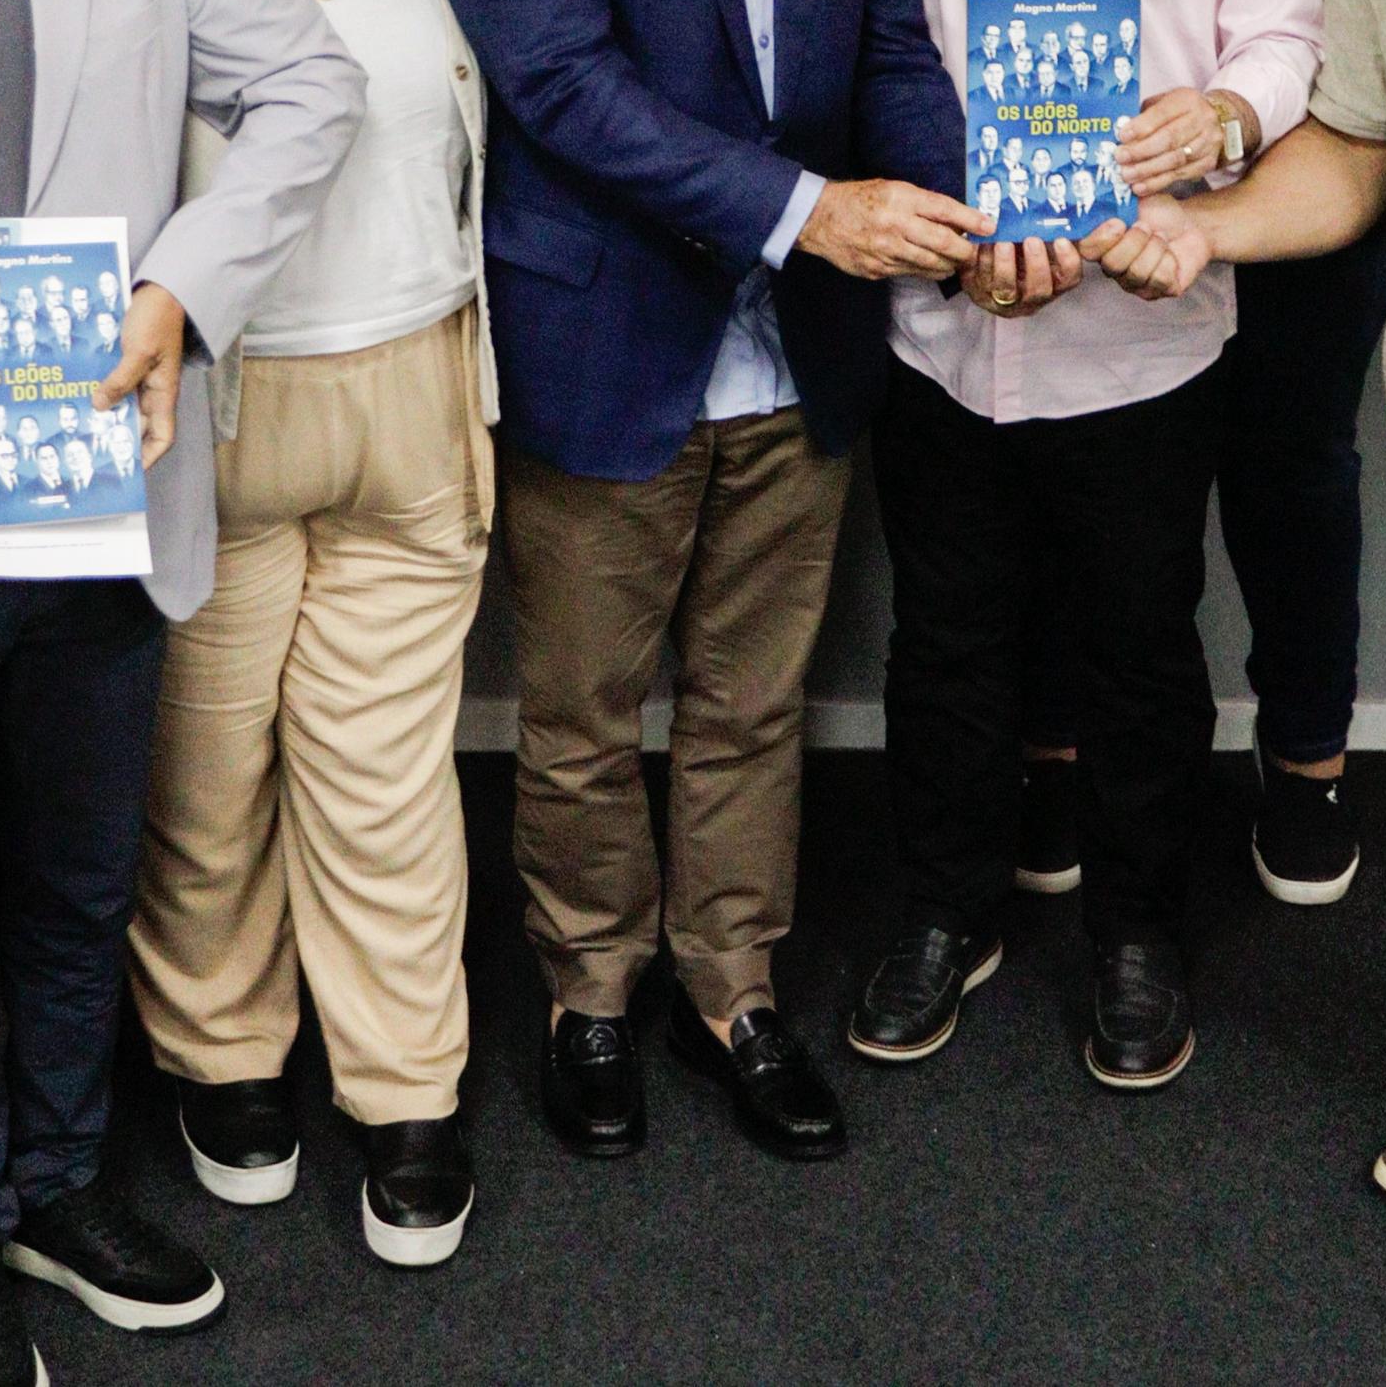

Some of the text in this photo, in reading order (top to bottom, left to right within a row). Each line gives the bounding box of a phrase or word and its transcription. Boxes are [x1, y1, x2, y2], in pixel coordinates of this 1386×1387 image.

[1014, 1, 1098, 15] Magno Martins
[997, 105, 1021, 121] OS
[1030, 120, 1053, 135] DO
[13, 384, 38, 402] DO
